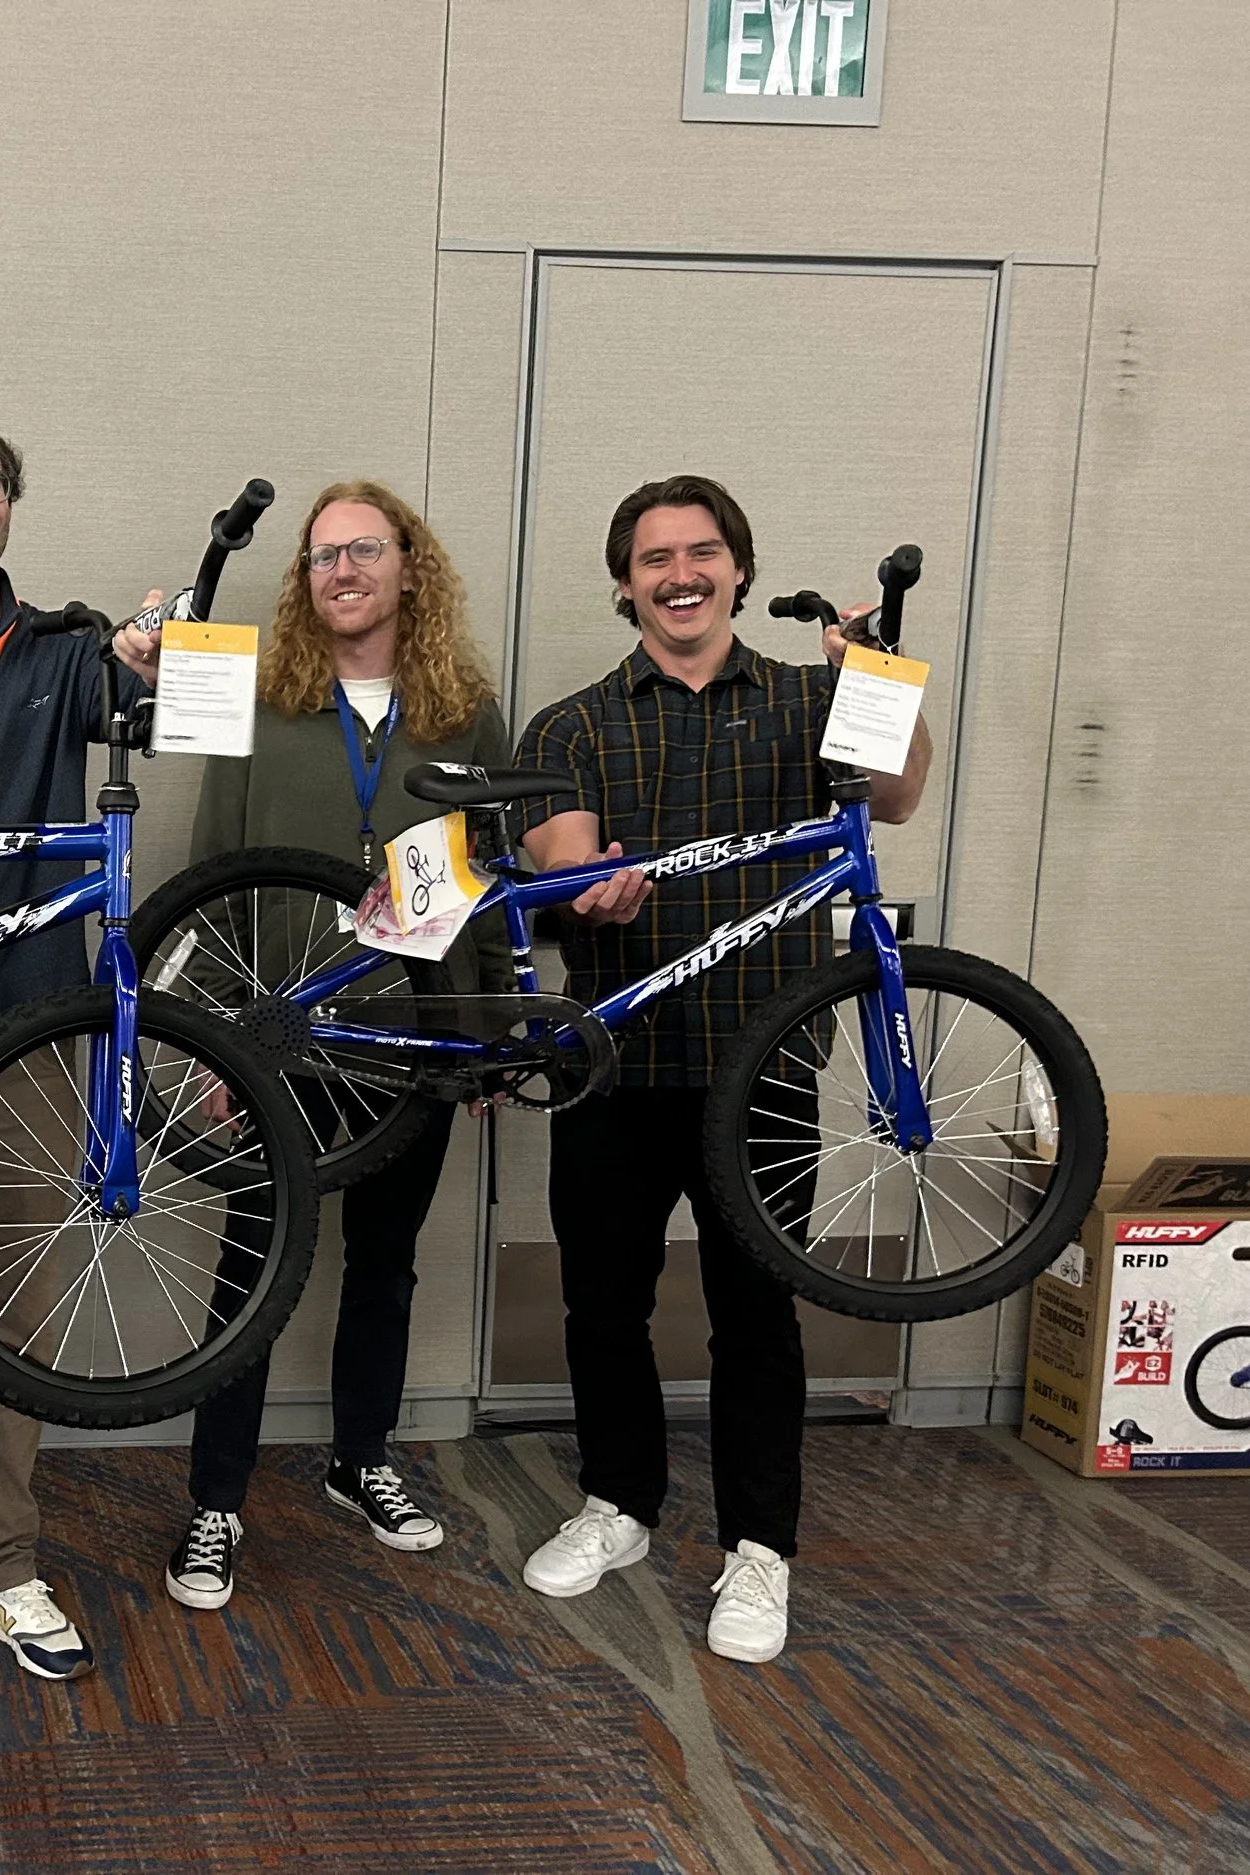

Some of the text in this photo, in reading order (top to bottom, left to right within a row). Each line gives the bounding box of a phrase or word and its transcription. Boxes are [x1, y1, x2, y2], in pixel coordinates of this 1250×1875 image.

[726, 0, 854, 97] EXIT
[654, 829, 778, 879] ROCK IT
[674, 900, 789, 987] HUFFY
[894, 1012, 912, 1069] HUFFY
[121, 1055, 132, 1123] HUFFY
[1124, 1226, 1208, 1239] HUFFY
[1121, 1254, 1169, 1268] RFID
[1138, 1371, 1167, 1381] BUILD
[1132, 1456, 1166, 1467] ROCK
